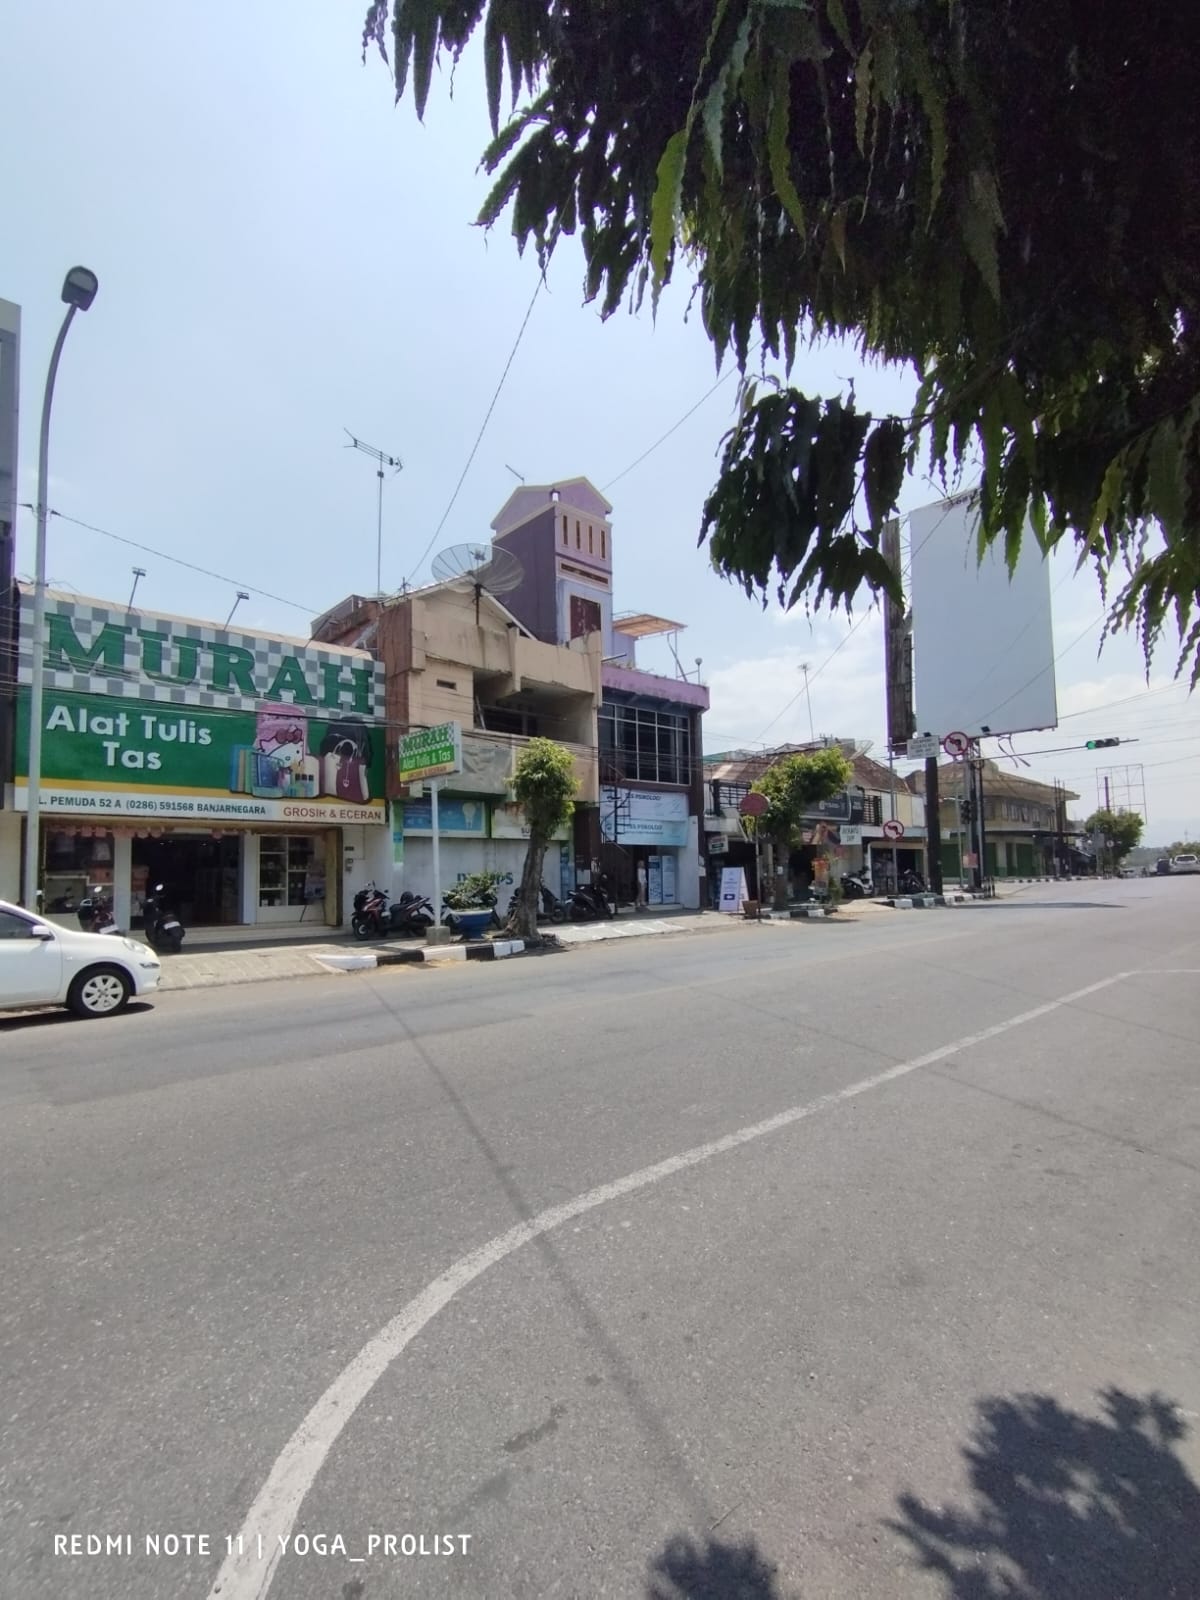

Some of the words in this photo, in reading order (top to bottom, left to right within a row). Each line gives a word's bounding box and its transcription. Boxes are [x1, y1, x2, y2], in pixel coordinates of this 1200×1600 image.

[43, 612, 374, 715] MURAH
[46, 705, 130, 737] Alat
[141, 715, 212, 745] Tulis
[402, 727, 449, 754] MURAH
[103, 741, 162, 770] Tas
[50, 796, 96, 807] PEMUDA
[99, 798, 112, 808] 52
[114, 799, 122, 809] A
[126, 799, 158, 811] (0286)
[159, 801, 194, 812] 591568
[197, 803, 267, 815] BANJARNEGARA
[340, 809, 382, 820] ECERAN
